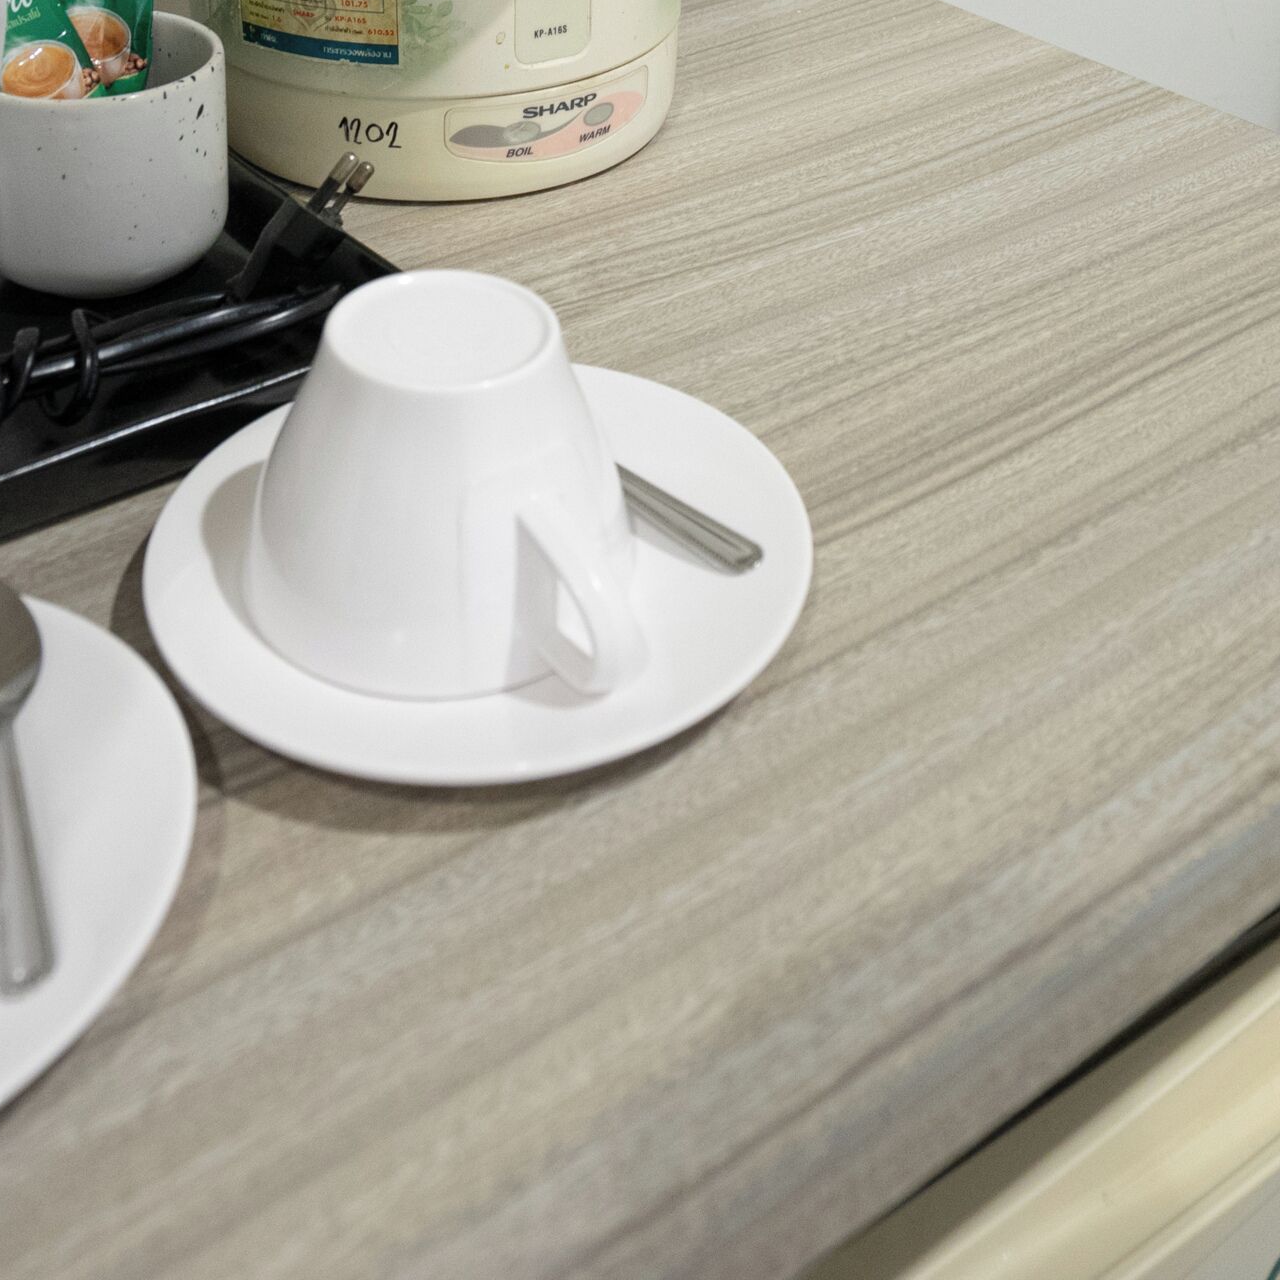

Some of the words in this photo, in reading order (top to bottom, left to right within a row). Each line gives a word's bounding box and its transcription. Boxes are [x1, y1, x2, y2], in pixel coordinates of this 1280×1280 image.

[340, 0, 369, 8] 101.75
[533, 25, 568, 40] KP-A16S
[522, 93, 598, 119] SHARP
[338, 116, 402, 149] 1202
[578, 124, 612, 143] WARM
[505, 147, 534, 158] BOIL
